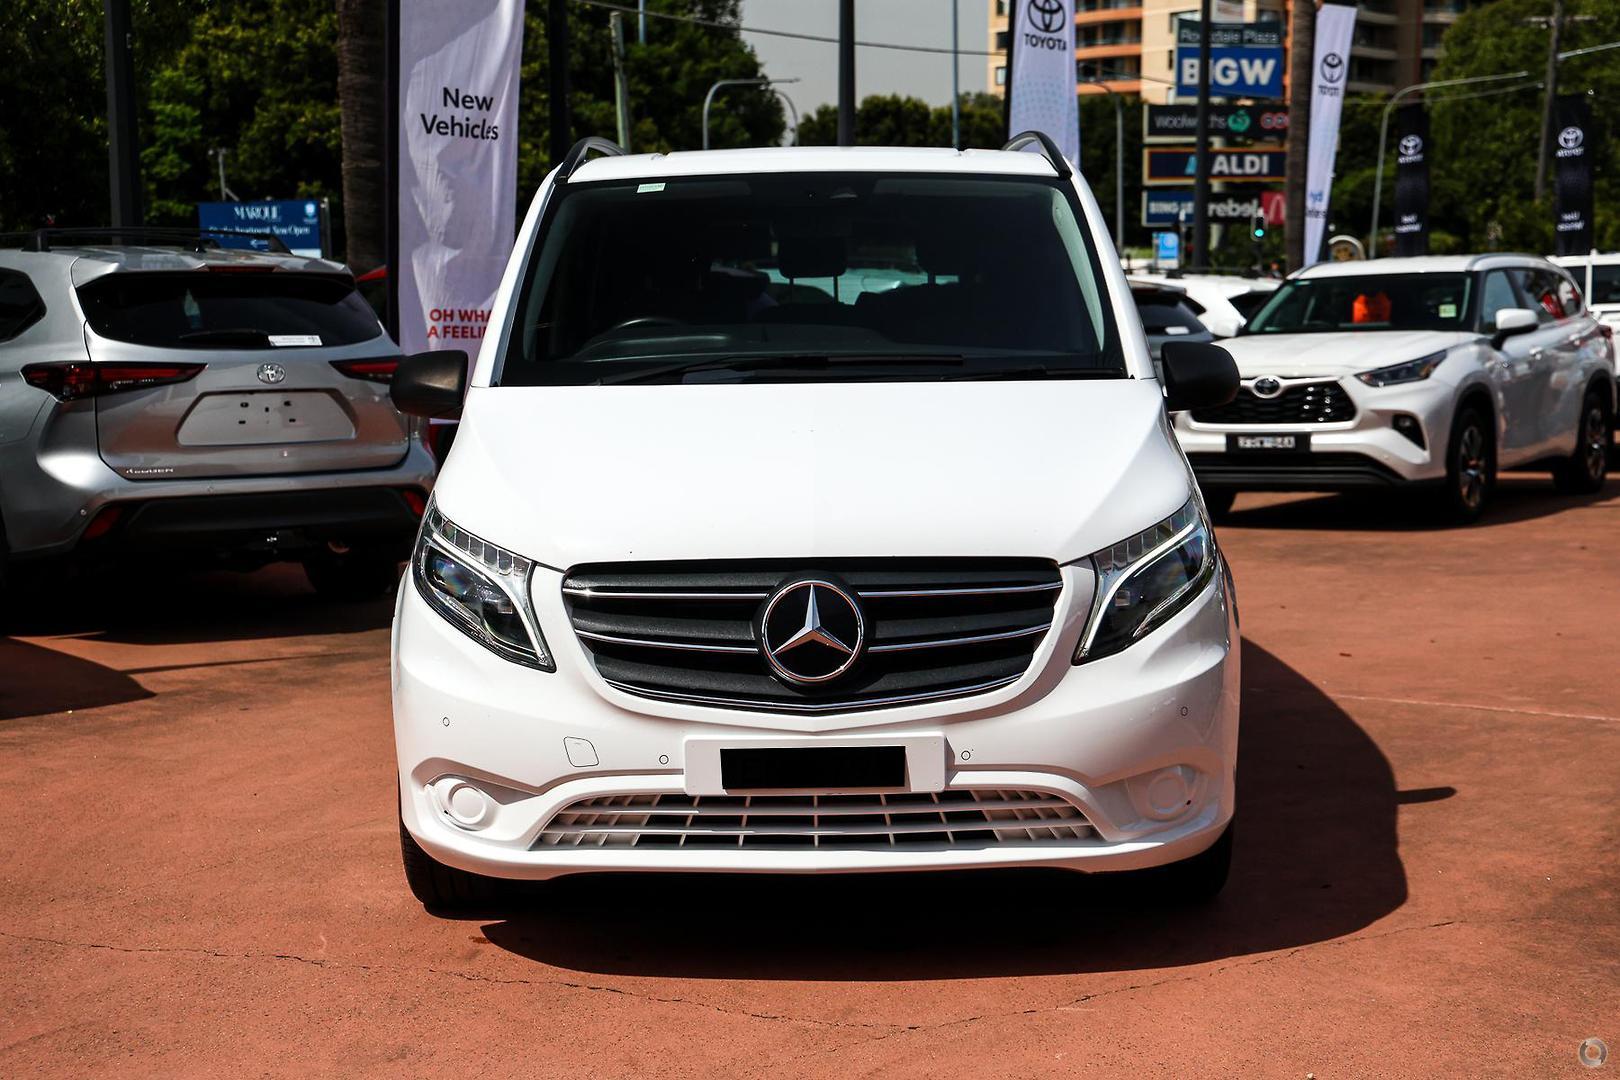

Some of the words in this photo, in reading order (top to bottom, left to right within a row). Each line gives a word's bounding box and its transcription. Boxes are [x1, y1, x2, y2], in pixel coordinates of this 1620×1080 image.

[443, 86, 494, 112] New
[420, 113, 499, 141] Vehicles
[1211, 155, 1269, 175] ALDI
[1207, 198, 1259, 218] rebel
[429, 309, 454, 322] OH
[427, 326, 439, 338] A
